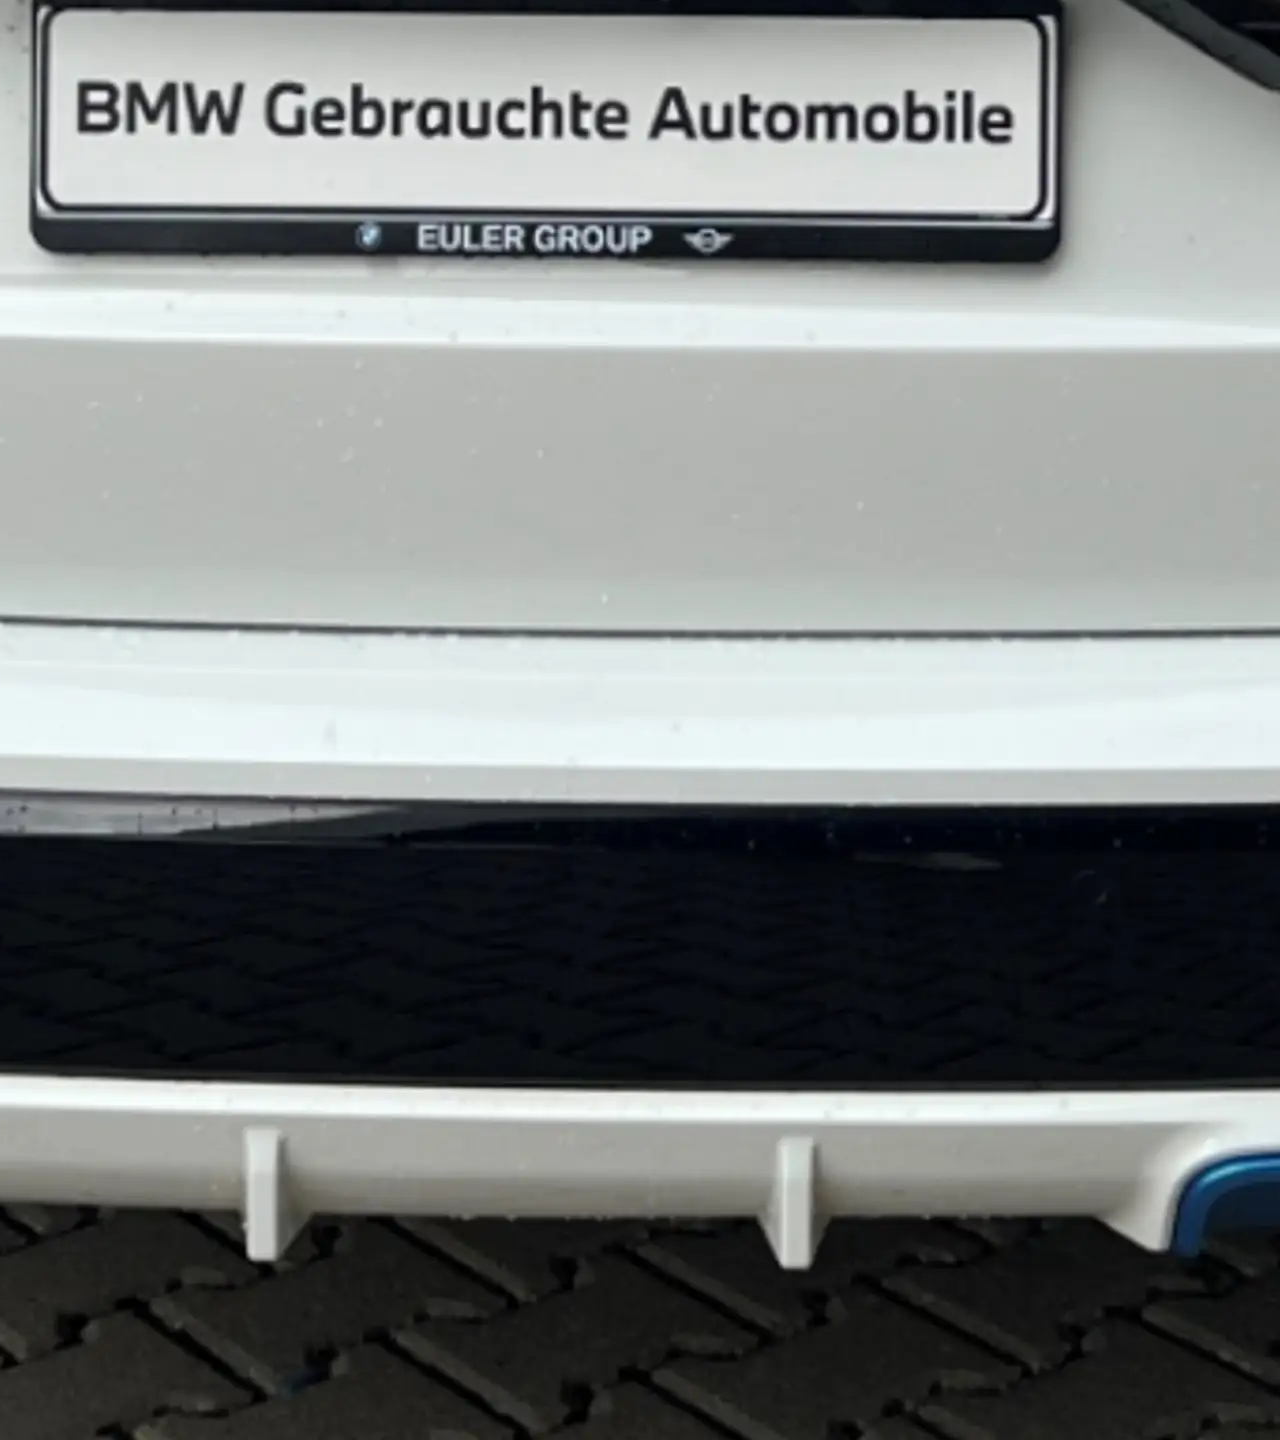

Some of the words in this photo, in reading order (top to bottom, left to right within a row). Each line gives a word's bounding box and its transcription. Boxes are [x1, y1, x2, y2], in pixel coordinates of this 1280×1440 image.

[77, 80, 245, 135] BMW
[265, 81, 630, 141] Gebrauchte
[648, 86, 1015, 145] Automobile
[417, 224, 526, 253] EULER
[533, 224, 653, 254] GROUP
